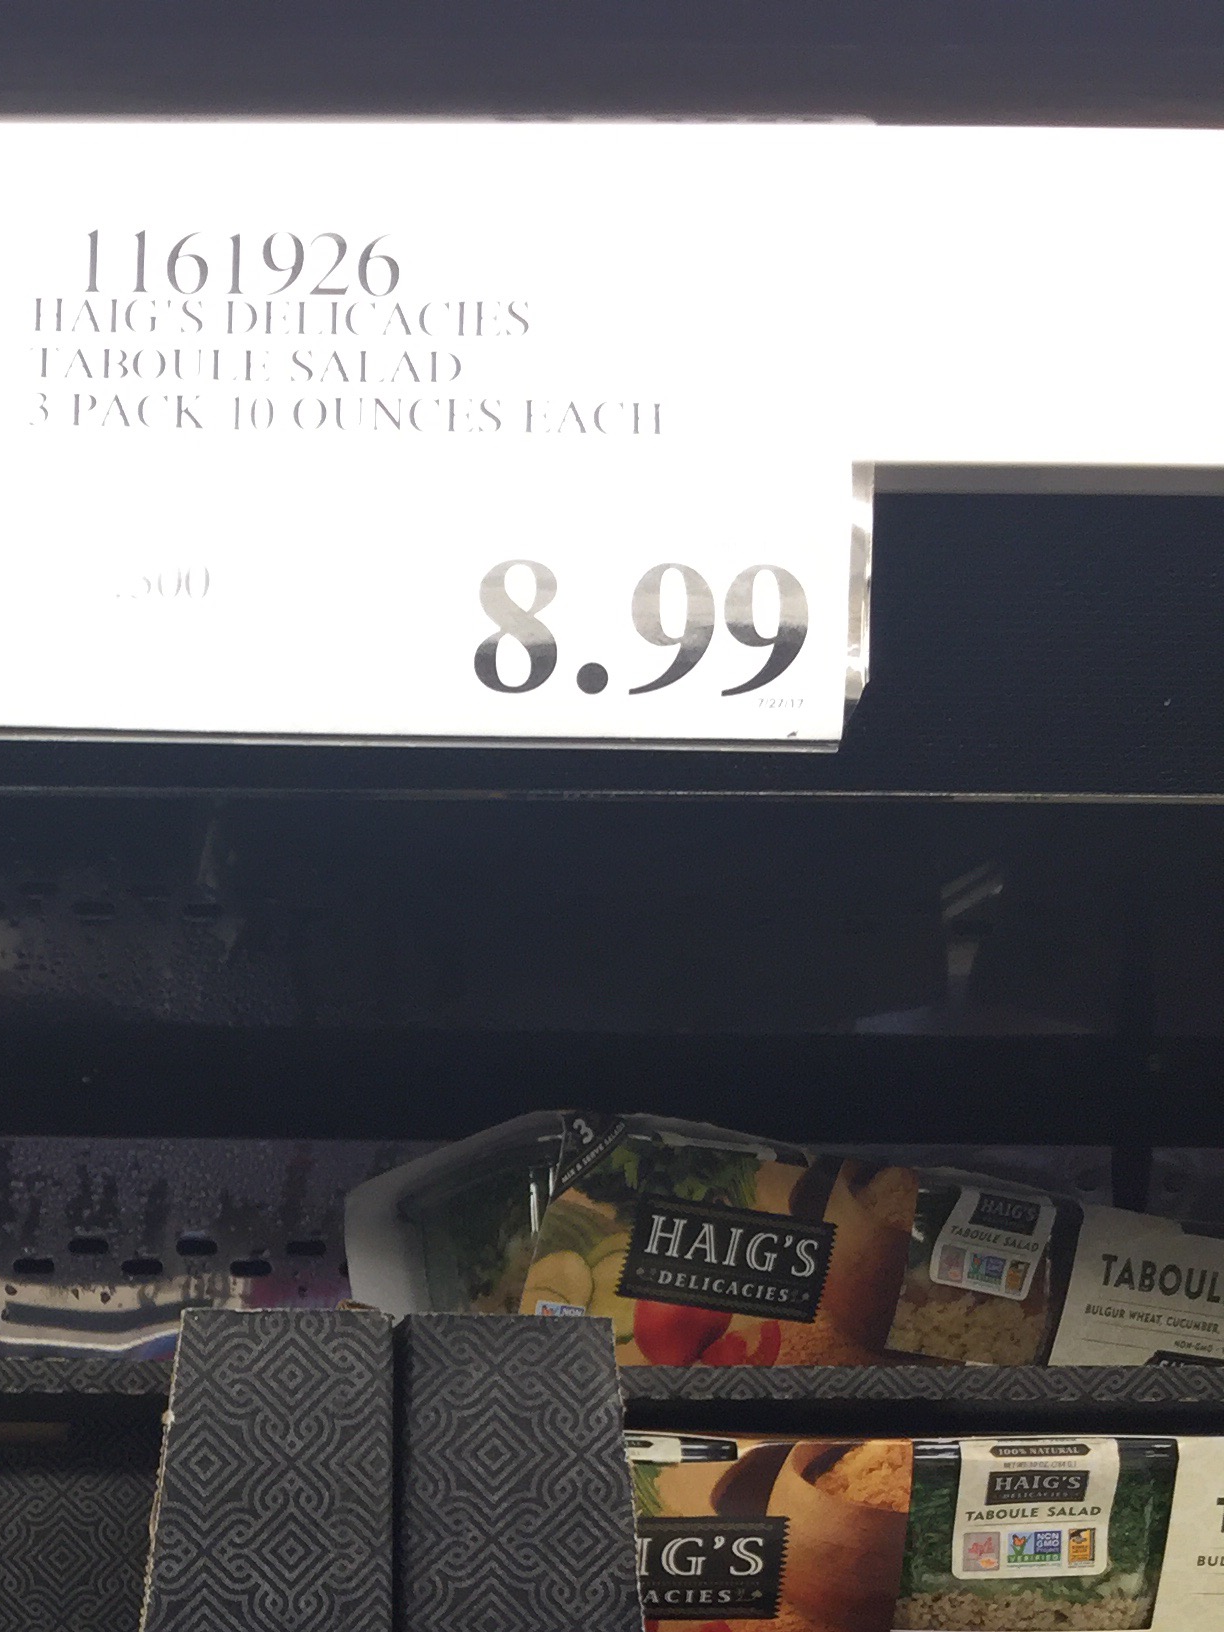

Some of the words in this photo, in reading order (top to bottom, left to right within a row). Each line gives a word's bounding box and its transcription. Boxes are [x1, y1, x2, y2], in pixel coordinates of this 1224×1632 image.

[85, 228, 400, 297] 1161926
[34, 298, 204, 333] HAIG'S
[227, 300, 530, 336] DELICACIES
[29, 348, 270, 381] TABOULE
[291, 350, 462, 383] SALAD
[73, 394, 204, 429] PACK
[233, 396, 274, 430] 10
[292, 397, 503, 433] OUNCES
[525, 400, 662, 435] EACH
[473, 558, 809, 697] 8.99
[644, 1213, 820, 1280] HAIG'S
[657, 1269, 791, 1304] DELICACIES
[1101, 1253, 1224, 1303] TABOUL
[994, 1475, 1082, 1492] HAIG'S
[965, 1507, 1040, 1522] TABOULE
[1046, 1506, 1102, 1518] SALAD
